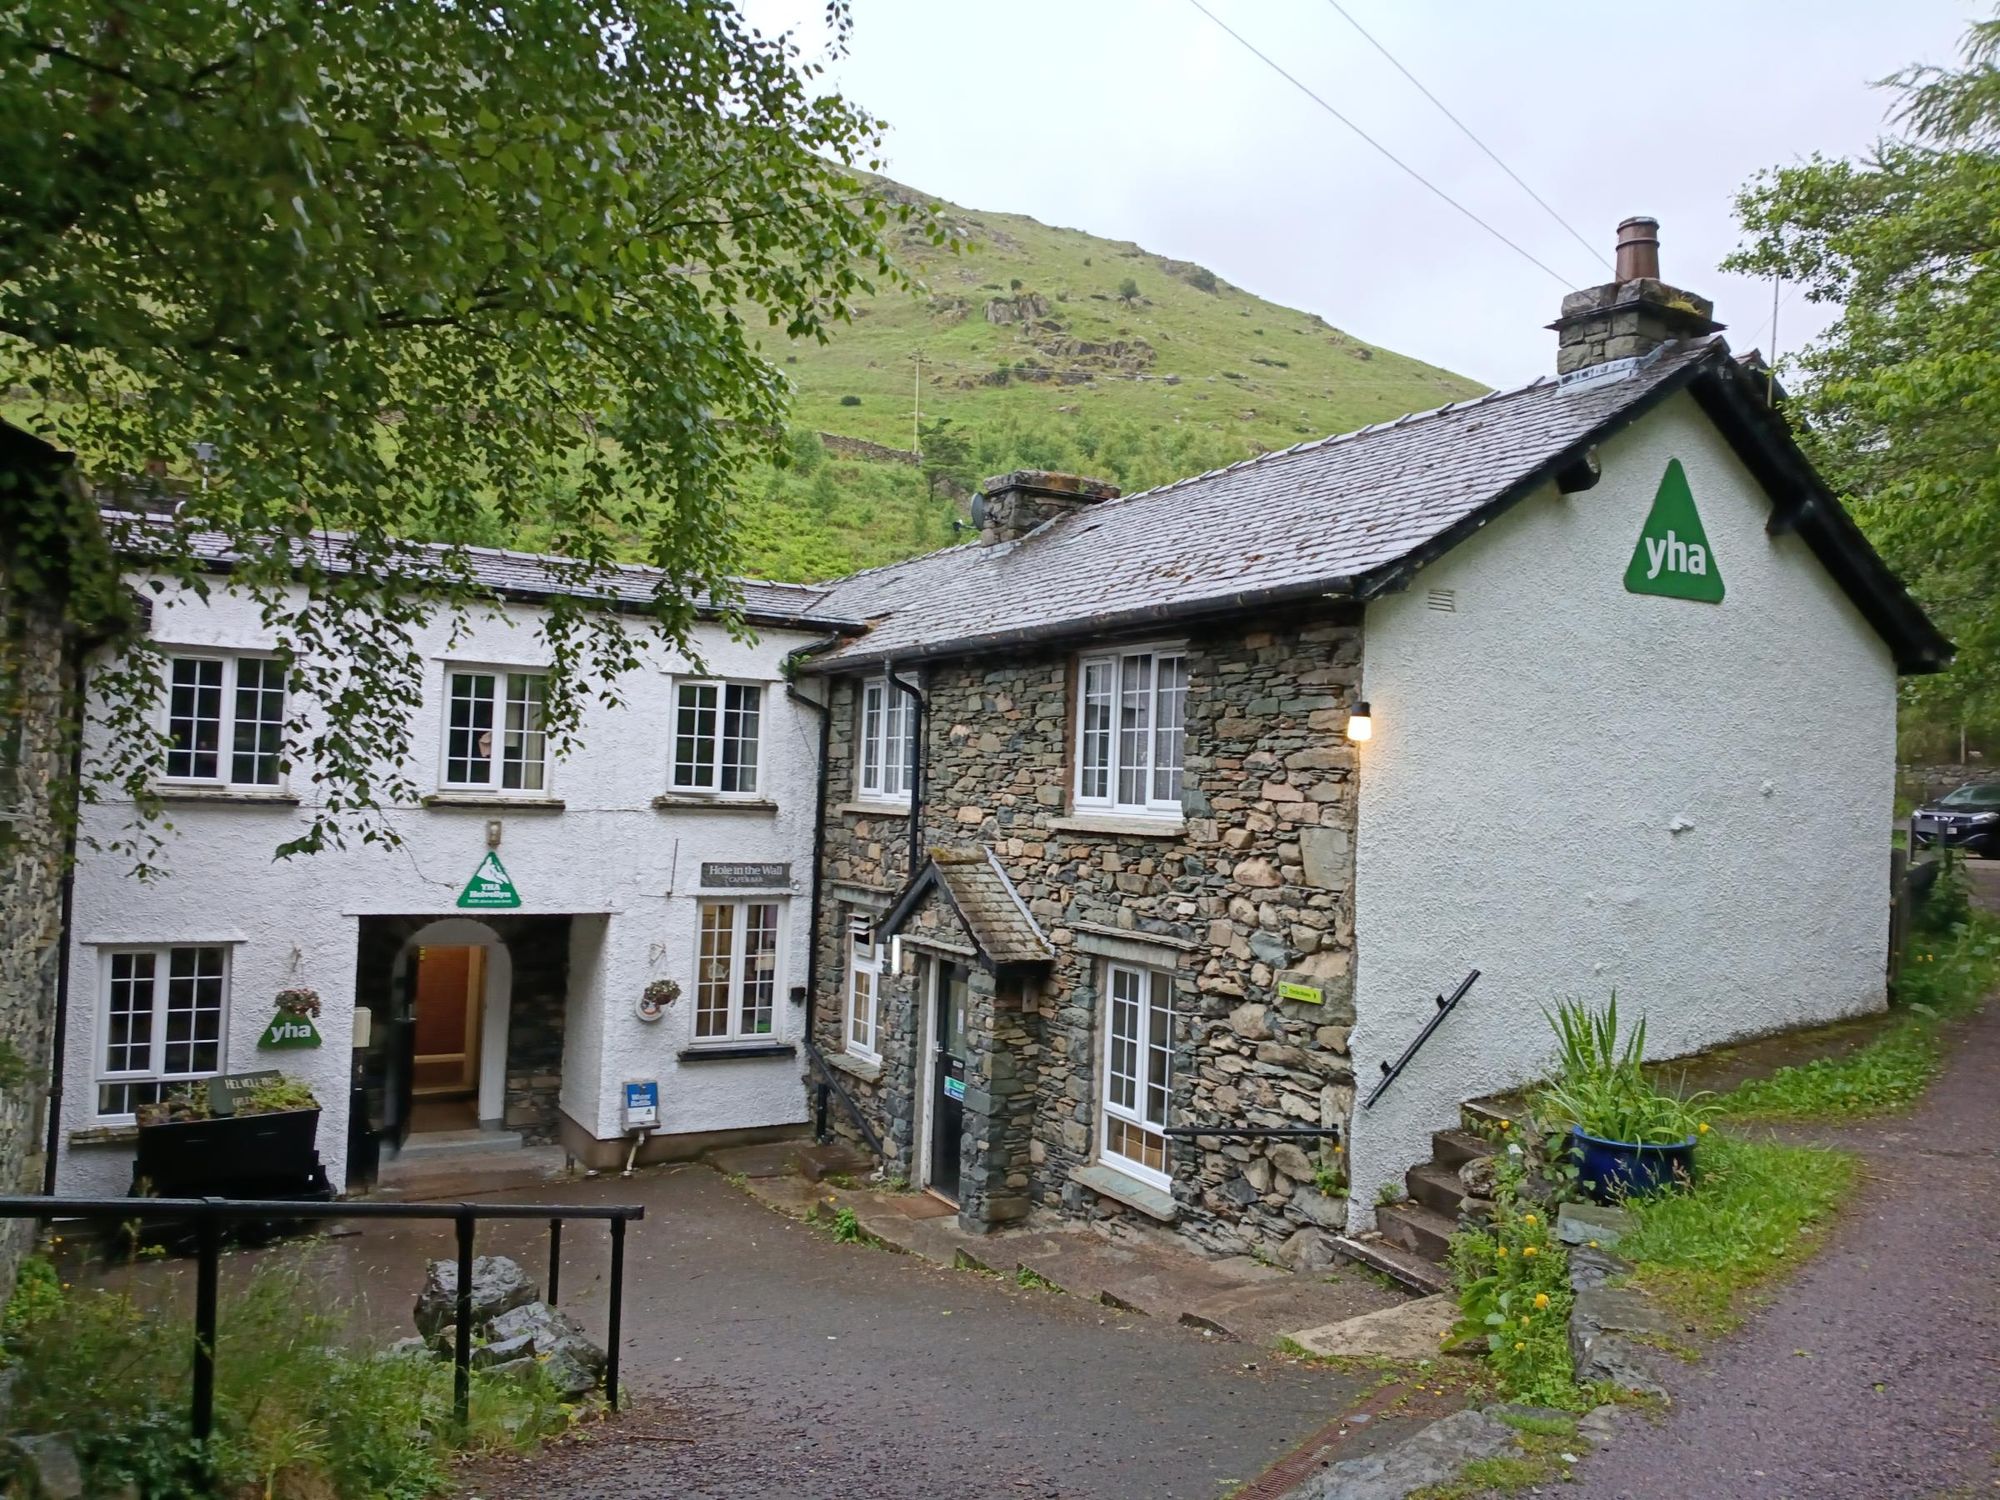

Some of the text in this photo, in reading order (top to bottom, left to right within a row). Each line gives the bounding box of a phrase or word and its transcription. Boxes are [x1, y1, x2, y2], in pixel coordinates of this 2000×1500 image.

[1645, 530, 1706, 579] yha
[709, 865, 782, 875] Hole in the Wall
[481, 883, 501, 891] YHA
[271, 1022, 311, 1043] yha
